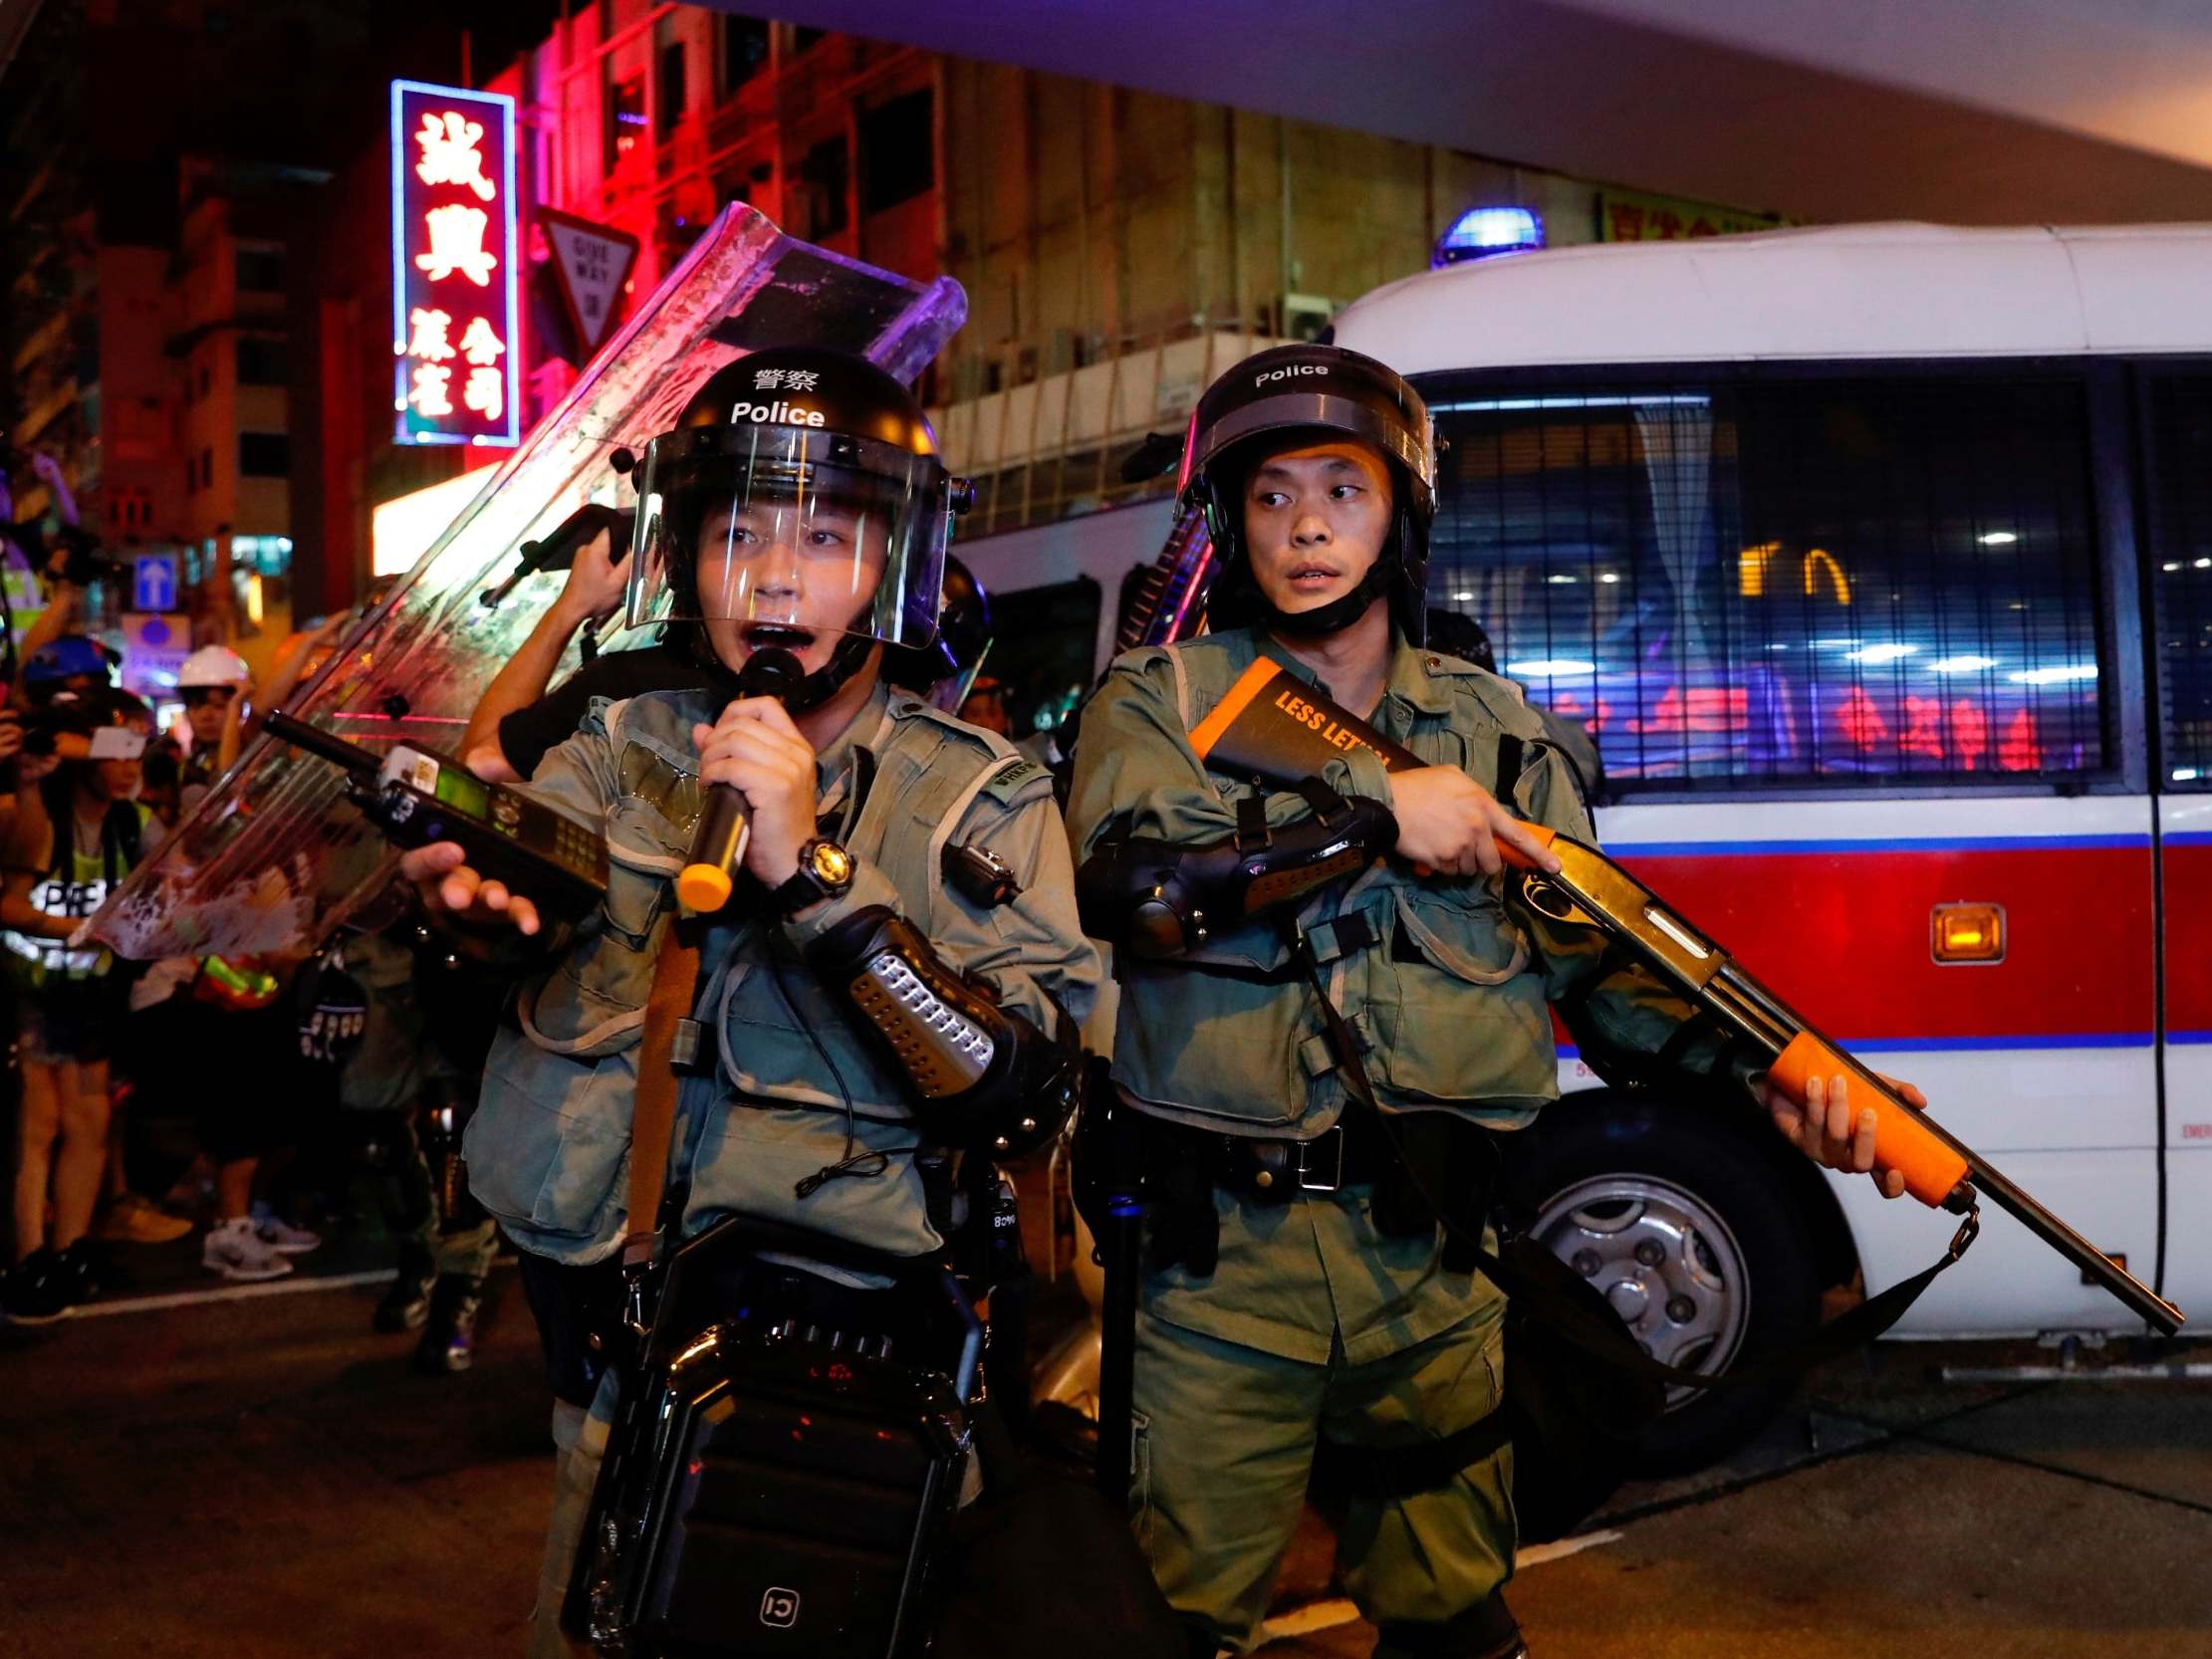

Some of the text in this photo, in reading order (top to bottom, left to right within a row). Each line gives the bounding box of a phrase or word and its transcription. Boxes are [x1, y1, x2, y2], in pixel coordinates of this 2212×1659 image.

[752, 368, 820, 392] 警察
[1256, 364, 1329, 388] Police
[730, 400, 826, 428] Police
[1274, 690, 1391, 766] LESS LET
[44, 884, 98, 917] PRE
